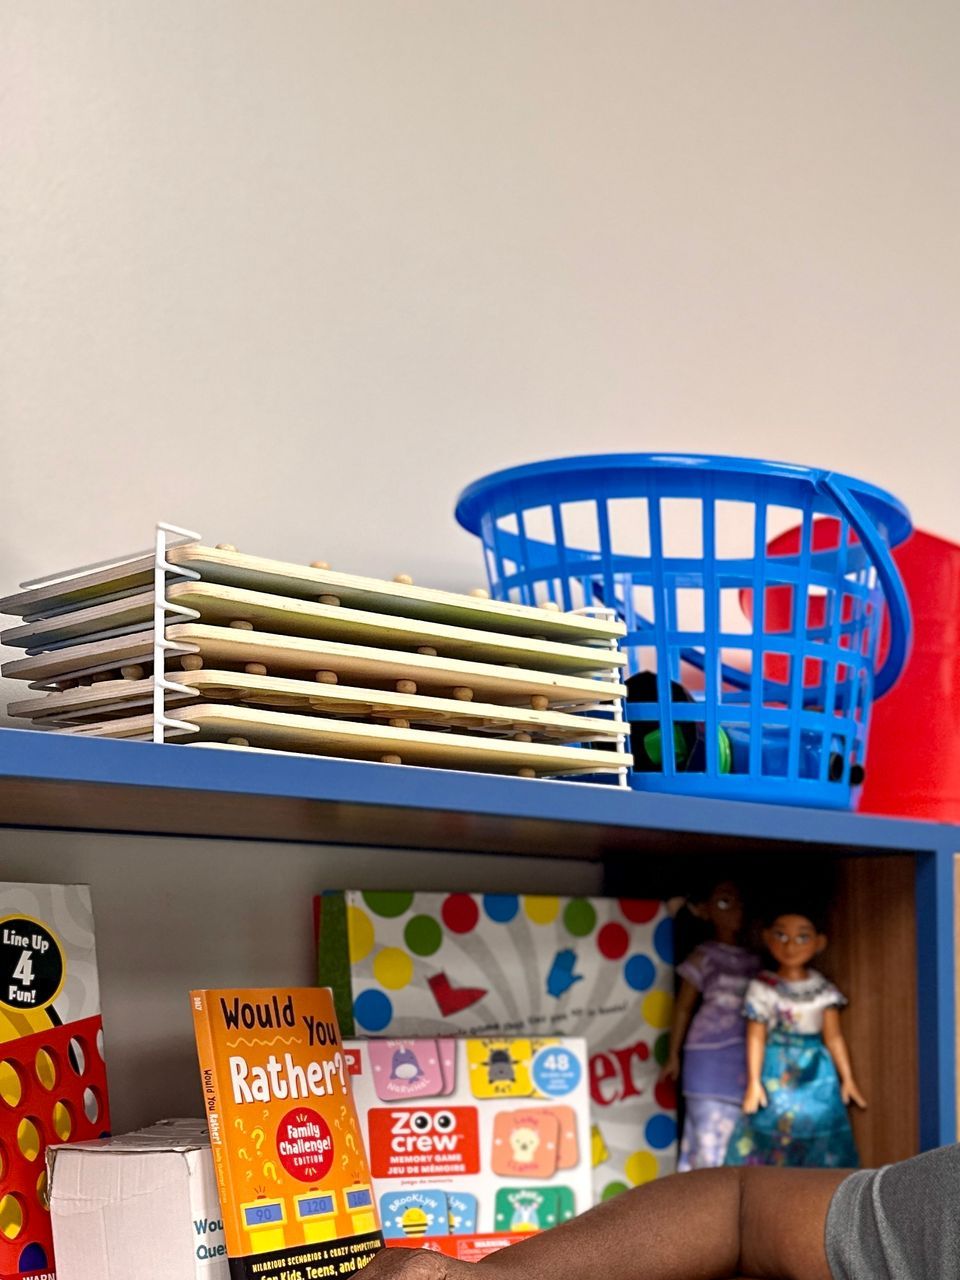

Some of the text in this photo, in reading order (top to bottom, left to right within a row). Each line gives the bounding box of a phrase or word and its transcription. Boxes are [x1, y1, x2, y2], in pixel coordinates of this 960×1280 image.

[3, 929, 49, 954] Line Up
[12, 950, 35, 986] 4
[8, 985, 36, 1003] Fun!
[220, 995, 338, 1046] Would You
[543, 1054, 570, 1071] 48
[203, 1069, 215, 1093] Would
[229, 1051, 347, 1104] Rather?
[208, 1096, 216, 1111] You
[287, 1122, 320, 1139] Family
[280, 1136, 331, 1155] Challenge!
[293, 1154, 323, 1166] EDITION
[390, 1154, 462, 1163] MEMORY GAME
[387, 1166, 405, 1175] JEU
[407, 1165, 420, 1174] DE
[255, 1207, 272, 1221] 90
[306, 1199, 327, 1214] 120
[193, 1218, 223, 1235] Wou
[196, 1244, 227, 1260] Que
[305, 1264, 338, 1280] Teens,
[339, 1257, 356, 1274] and
